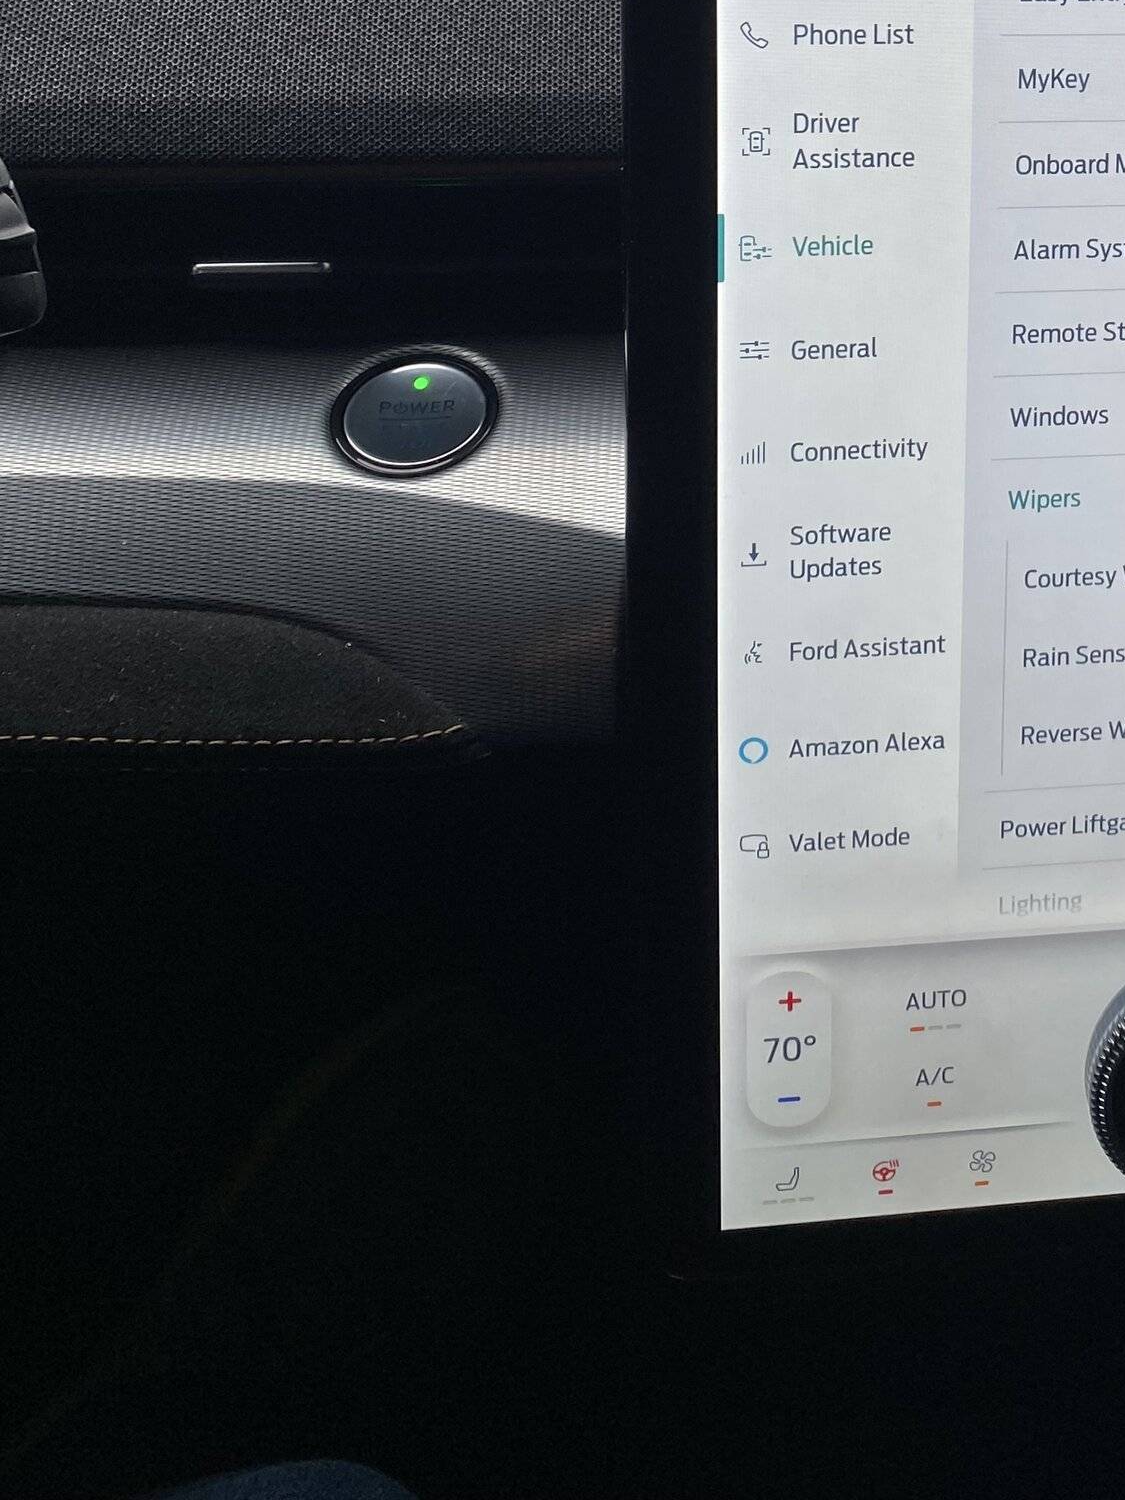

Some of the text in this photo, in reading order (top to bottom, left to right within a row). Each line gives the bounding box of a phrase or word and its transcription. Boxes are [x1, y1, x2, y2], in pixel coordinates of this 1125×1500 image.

[794, 23, 914, 45] Phone List
[1019, 69, 1089, 93] MyKey
[794, 113, 859, 133] Driver
[793, 148, 914, 169] Assistance
[1016, 153, 1109, 175] Onboard
[792, 234, 873, 256] Vehicle
[1014, 239, 1079, 260] Alarm
[1013, 324, 1096, 344] Remote
[792, 337, 877, 360] General
[378, 399, 456, 415] POWER
[1010, 405, 1108, 427] Windows
[791, 438, 928, 462] Connectivity
[1009, 490, 1080, 512] Wipers
[791, 524, 891, 545] Software
[791, 557, 881, 582] Updates
[1025, 569, 1116, 588] Courtesy
[791, 636, 945, 661] Ford Assistant
[1024, 647, 1069, 667] Rain
[789, 732, 944, 757] Amazon Alexa
[1022, 726, 1102, 744] Reverse
[789, 827, 909, 852] Valet Mode
[1001, 821, 1066, 839] Power
[1000, 893, 1081, 915] Lighting
[906, 990, 966, 1010] AUTO
[764, 1035, 816, 1063] 70°
[916, 1067, 953, 1086] A/C
